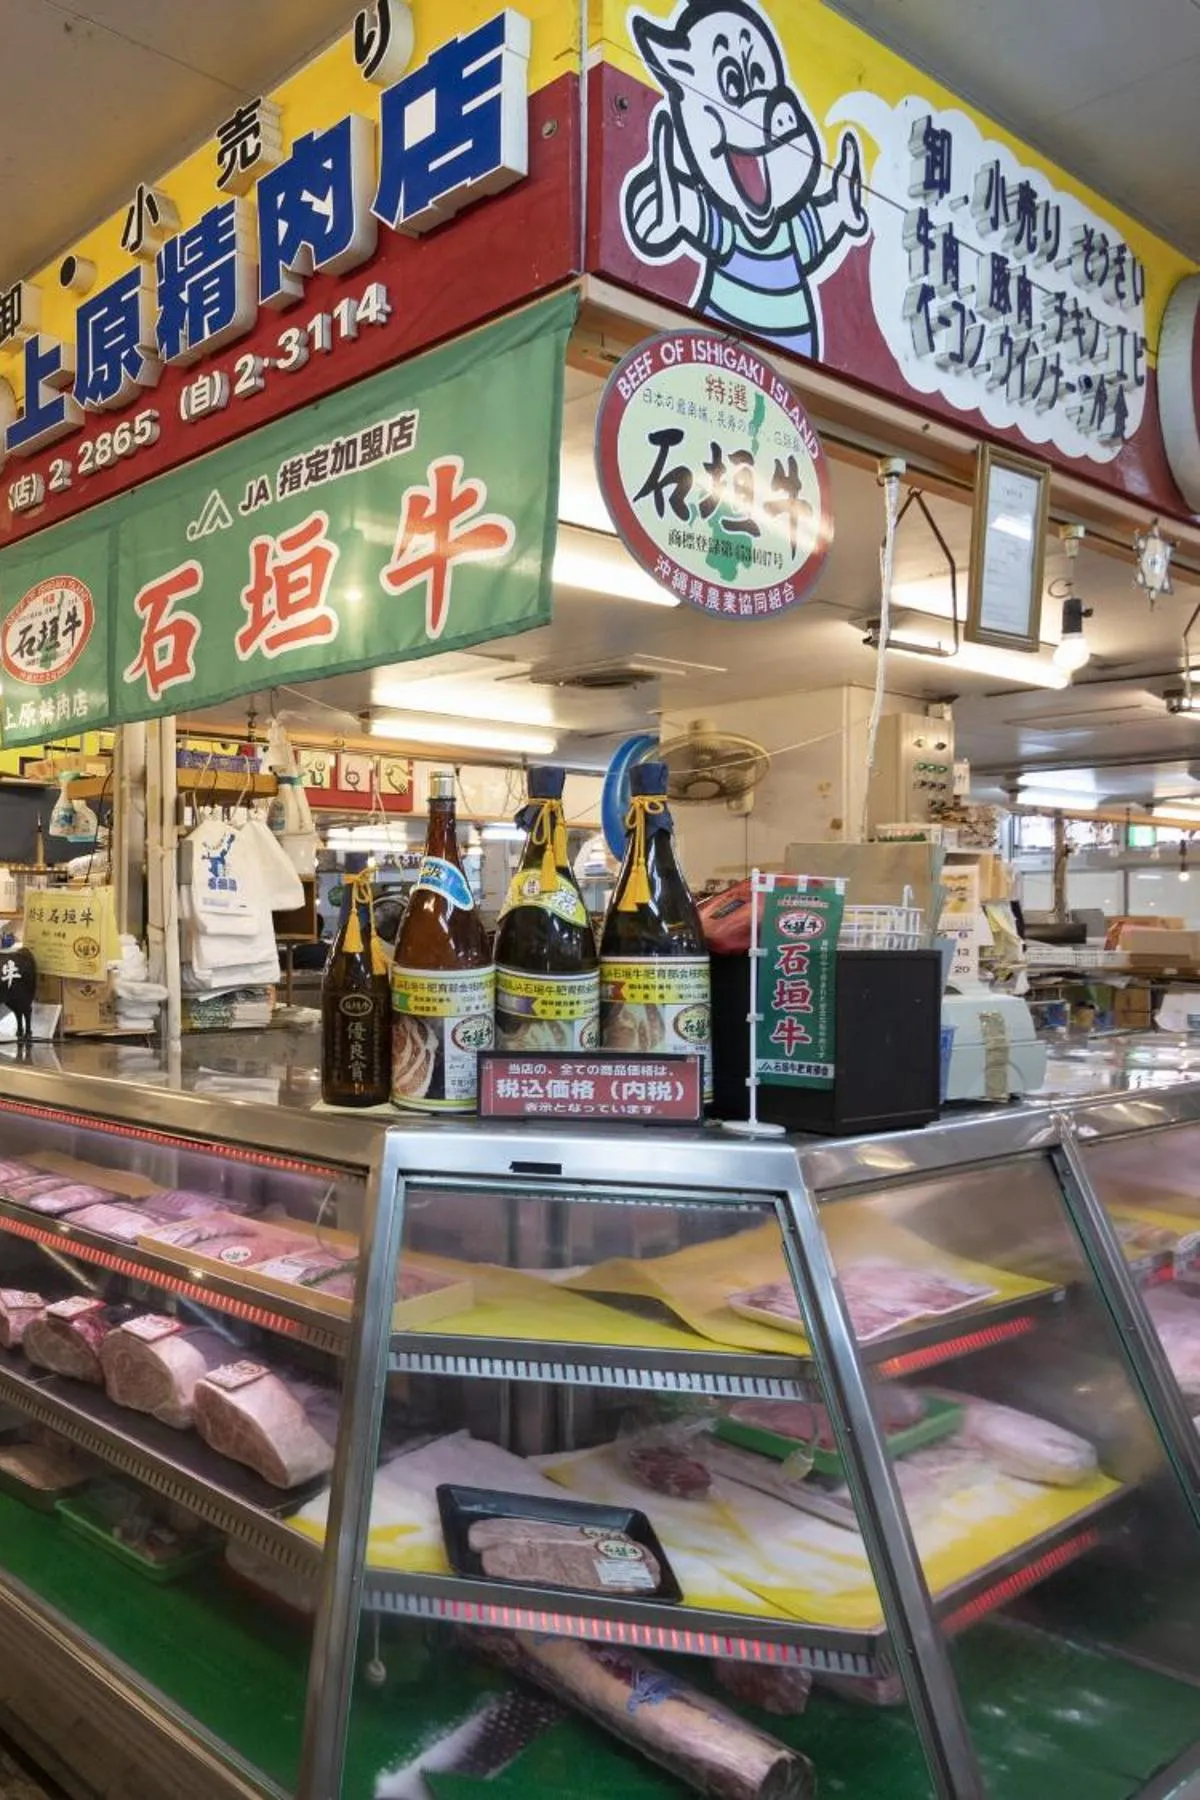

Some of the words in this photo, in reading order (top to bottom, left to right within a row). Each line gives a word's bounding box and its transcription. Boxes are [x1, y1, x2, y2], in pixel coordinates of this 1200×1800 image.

[4, 10, 512, 454] 上原精肉店
[617, 353, 653, 399] BEEF
[660, 343, 685, 364] OF
[692, 338, 765, 385] ISHIGAKI
[770, 382, 819, 460] ISLAND
[705, 373, 748, 414] 特選
[277, 409, 420, 499] 指定加盟店
[633, 428, 813, 562] 石垣牛
[123, 455, 515, 704] 石垣牛
[11, 605, 82, 658] 石垣牛
[4, 688, 89, 730] 上原精肉店
[48, 908, 94, 928] 石垣牛
[770, 943, 813, 1056] 石垣牛
[497, 1079, 595, 1100] 税込価格
